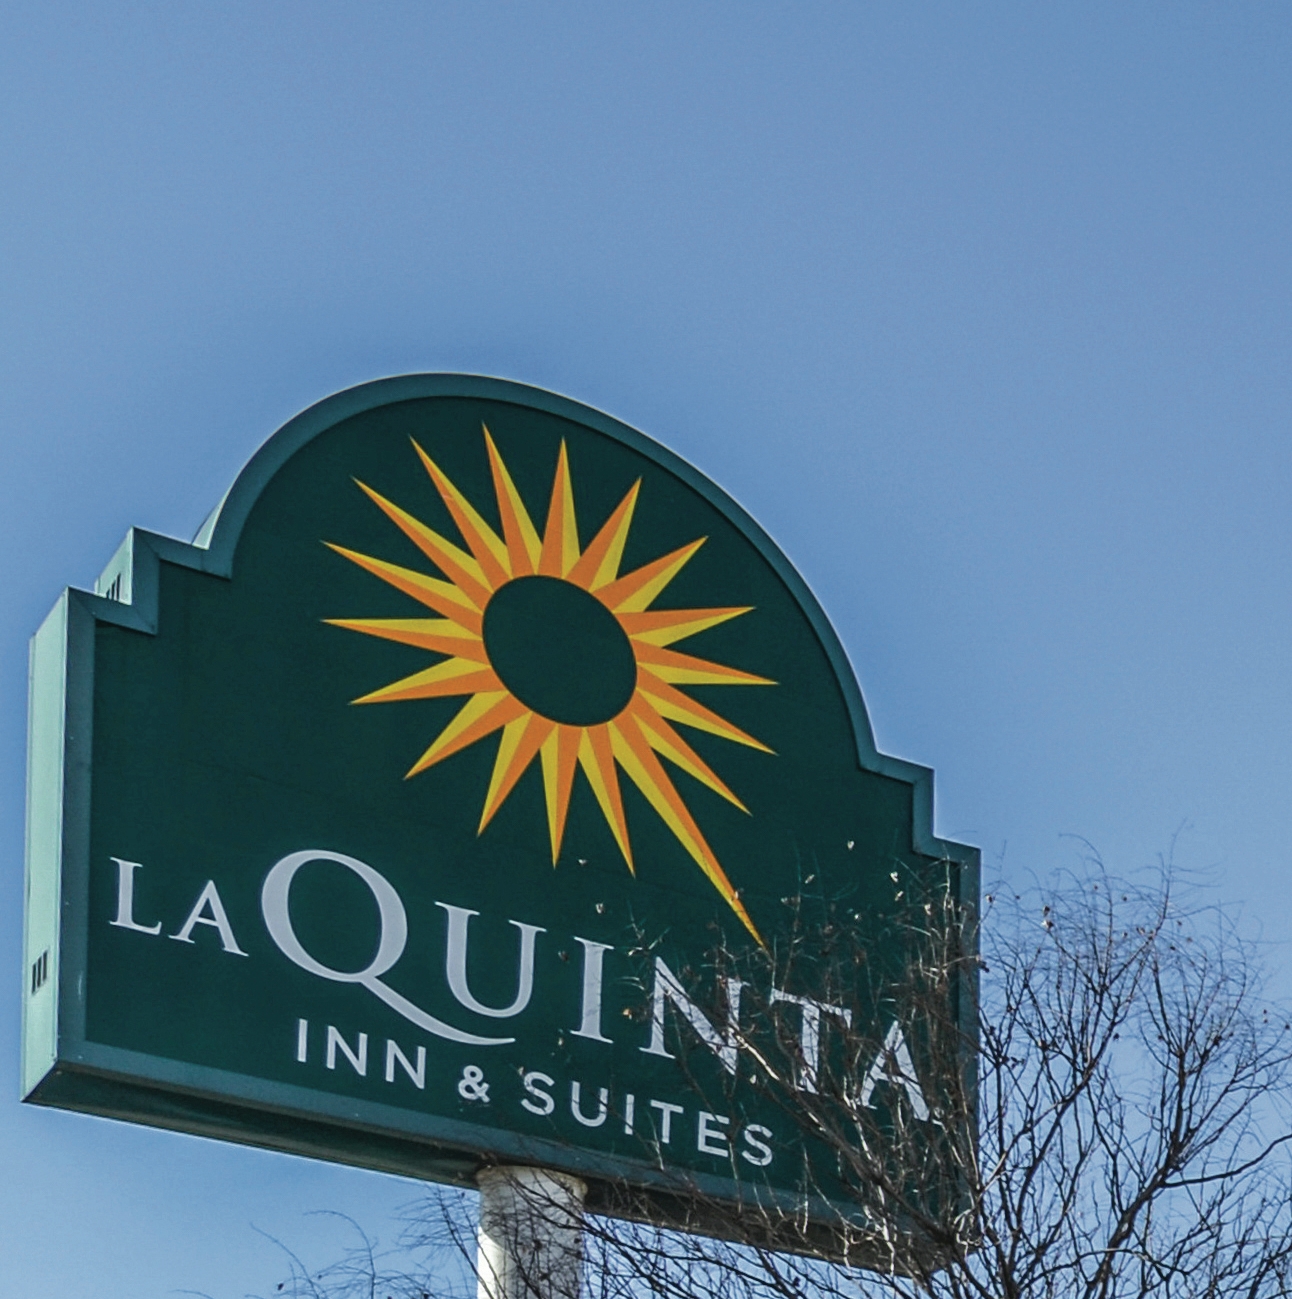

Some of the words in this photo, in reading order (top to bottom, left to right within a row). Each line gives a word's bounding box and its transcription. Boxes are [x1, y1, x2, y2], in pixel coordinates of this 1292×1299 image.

[109, 856, 249, 957] LA
[261, 849, 941, 1123] QUINTA
[296, 1018, 426, 1090] INN
[457, 1064, 491, 1103] &
[520, 1070, 774, 1168] SUITES
